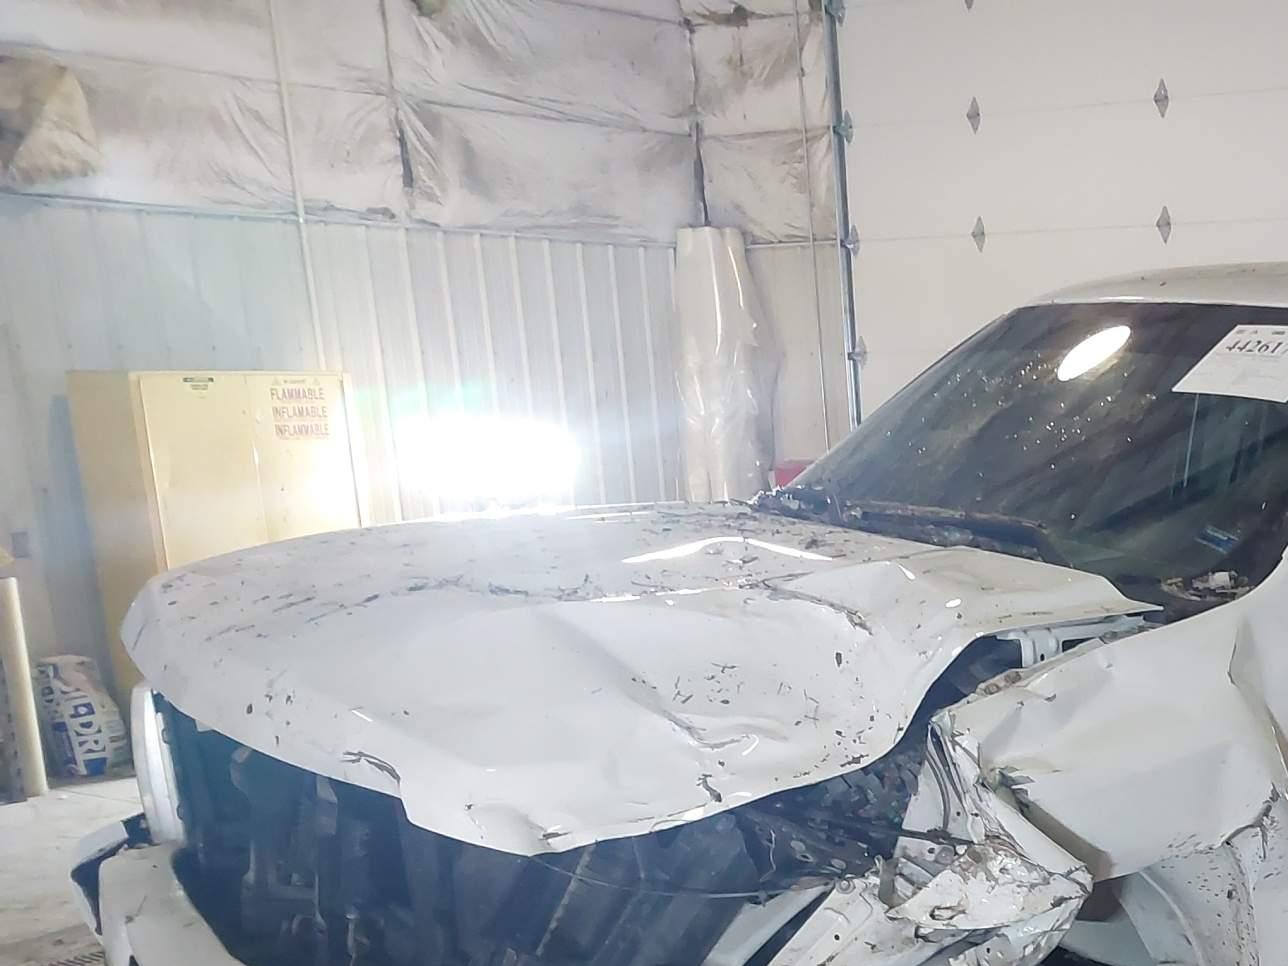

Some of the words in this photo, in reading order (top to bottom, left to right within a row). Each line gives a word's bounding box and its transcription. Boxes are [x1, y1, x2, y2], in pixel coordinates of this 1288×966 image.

[270, 387, 325, 401] FLAMMABLE
[272, 405, 328, 418] INFLAMABLE
[274, 423, 330, 437] INFLAMMABLE
